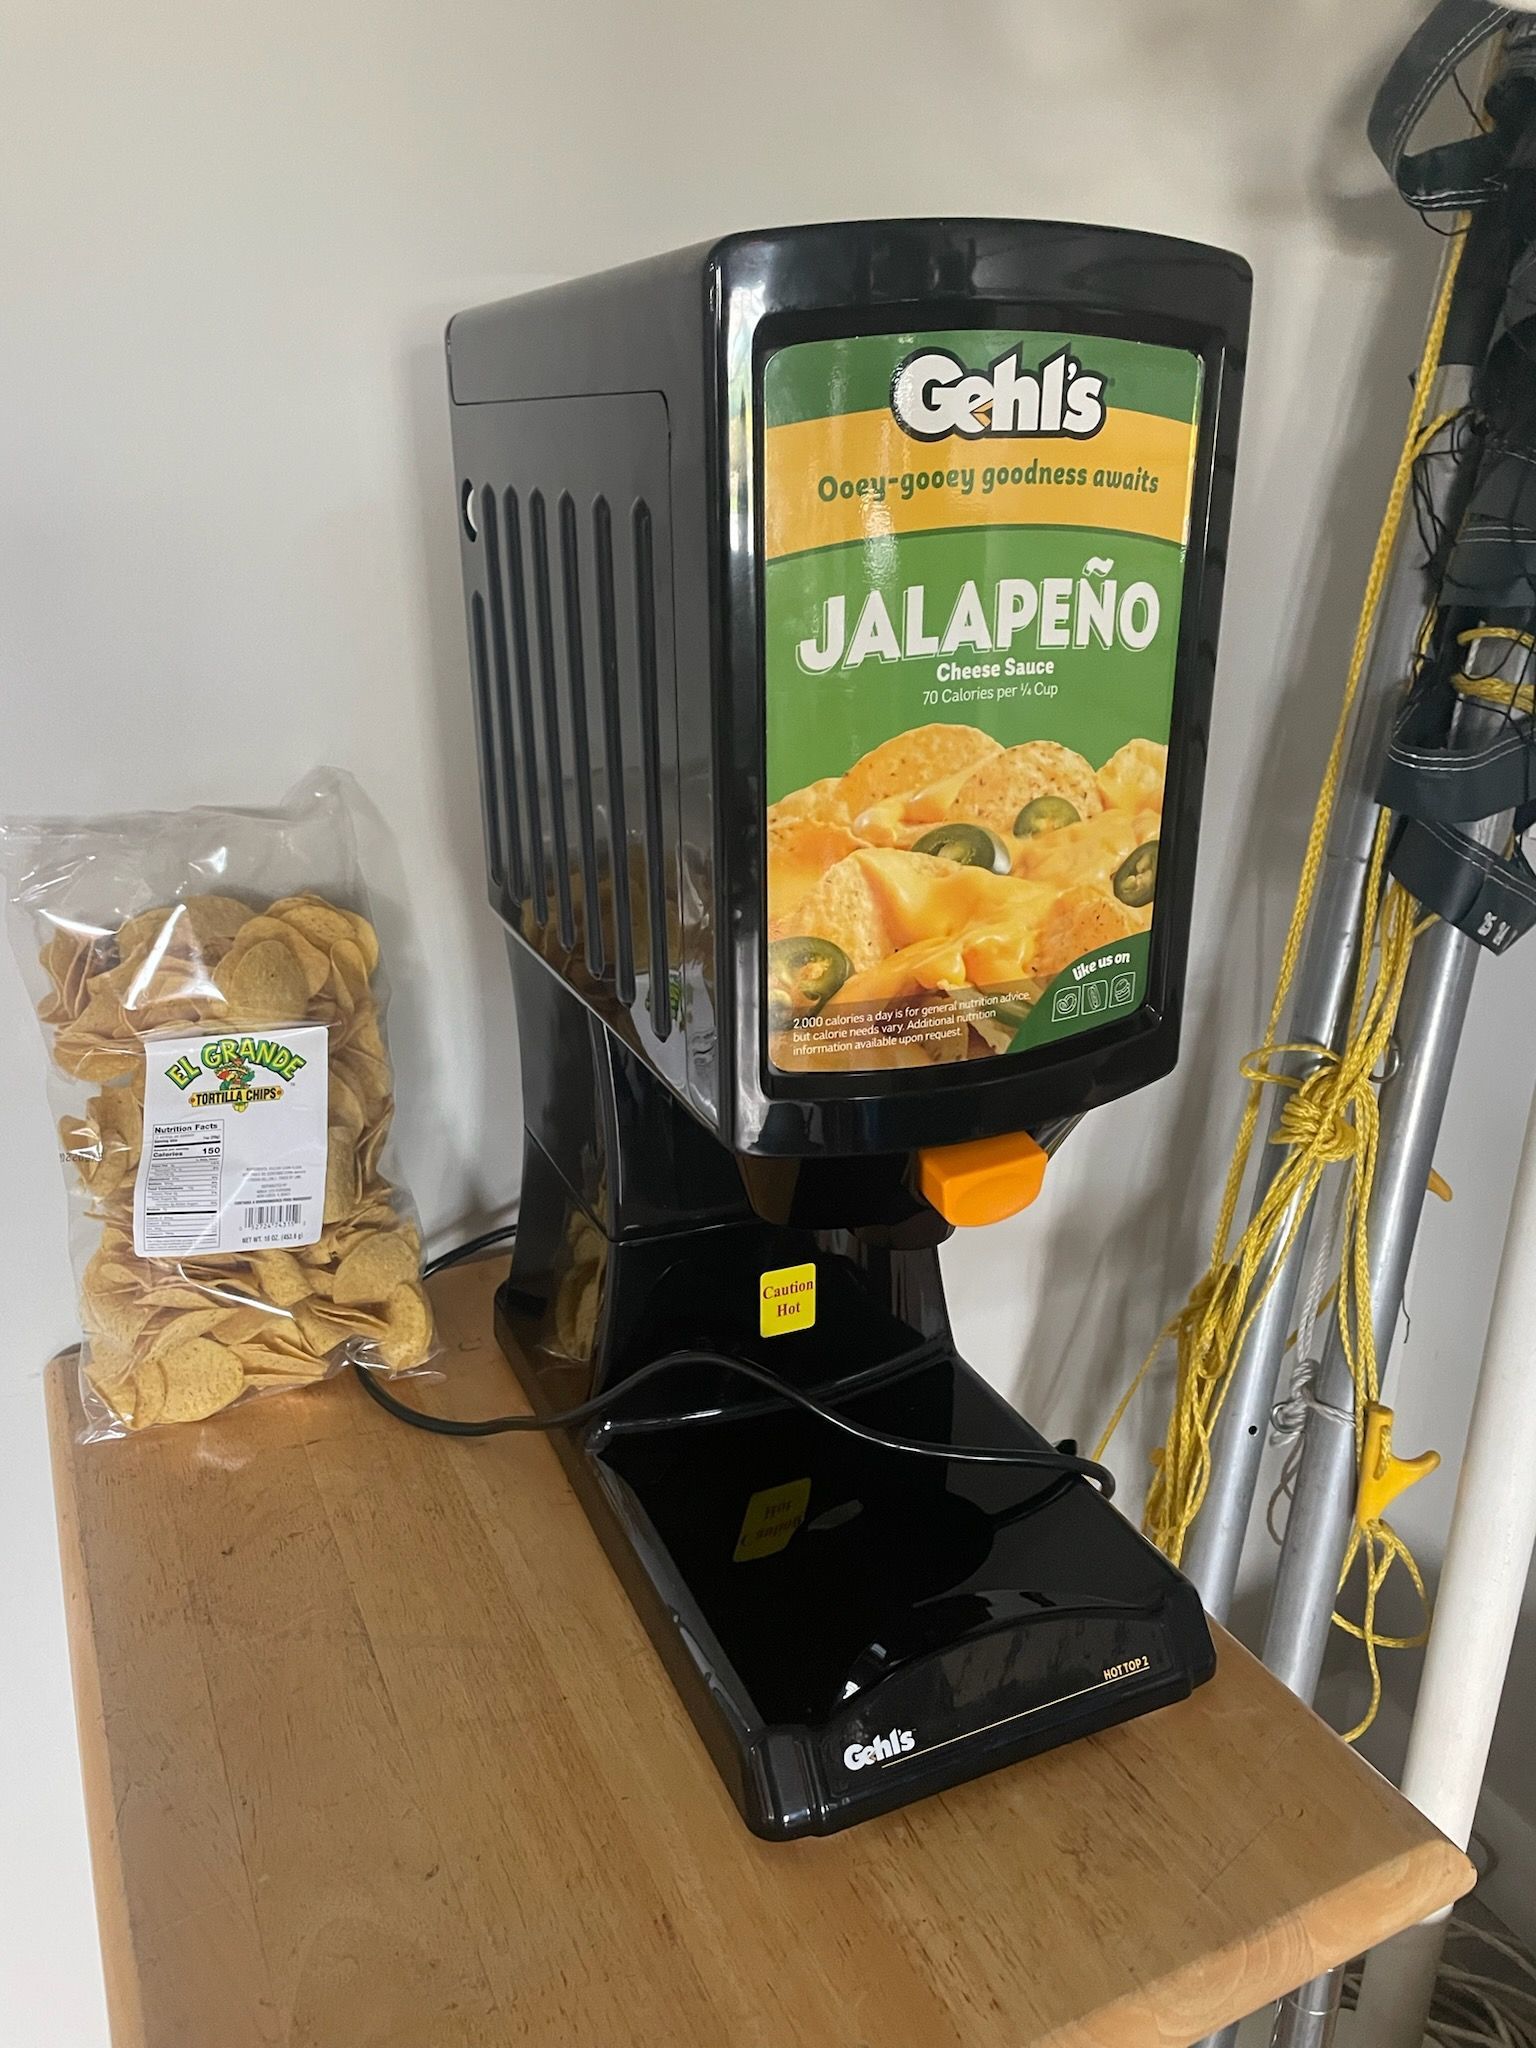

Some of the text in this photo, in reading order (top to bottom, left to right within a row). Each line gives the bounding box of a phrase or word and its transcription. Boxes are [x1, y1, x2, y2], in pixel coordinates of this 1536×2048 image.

[891, 348, 1105, 437] Gehl's
[818, 458, 1159, 501] Ooey-gooey goodness awaits
[796, 556, 1161, 675] JALAPEÑO
[936, 657, 1055, 682] Cheese Sauce
[923, 690, 938, 705] 70
[941, 687, 994, 703] Calories
[996, 686, 1018, 702] per
[1034, 682, 1058, 698] Cup
[1071, 952, 1131, 982] like us on
[825, 1013, 865, 1026] calories
[866, 1014, 873, 1022] a
[875, 1010, 894, 1022] day
[895, 1008, 903, 1018] is
[905, 1006, 919, 1017] for
[921, 1001, 957, 1017] general
[959, 995, 999, 1010] nutrition
[793, 1008, 997, 1042] but calorie needs vary. Additional nutrition
[793, 1041, 853, 1056] information
[854, 1035, 897, 1050] available
[899, 1033, 923, 1045] upon
[164, 1037, 307, 1091] EL GRANDE
[196, 1087, 277, 1106] TORTILLA CHIPS
[154, 1123, 218, 1134] Nutrition Facts
[202, 1147, 221, 1155] 150
[763, 1280, 814, 1300] Caution
[777, 1302, 801, 1317] Hot
[1103, 1655, 1149, 1680] HOT TOP 2
[843, 1727, 916, 1771] Gehl's
